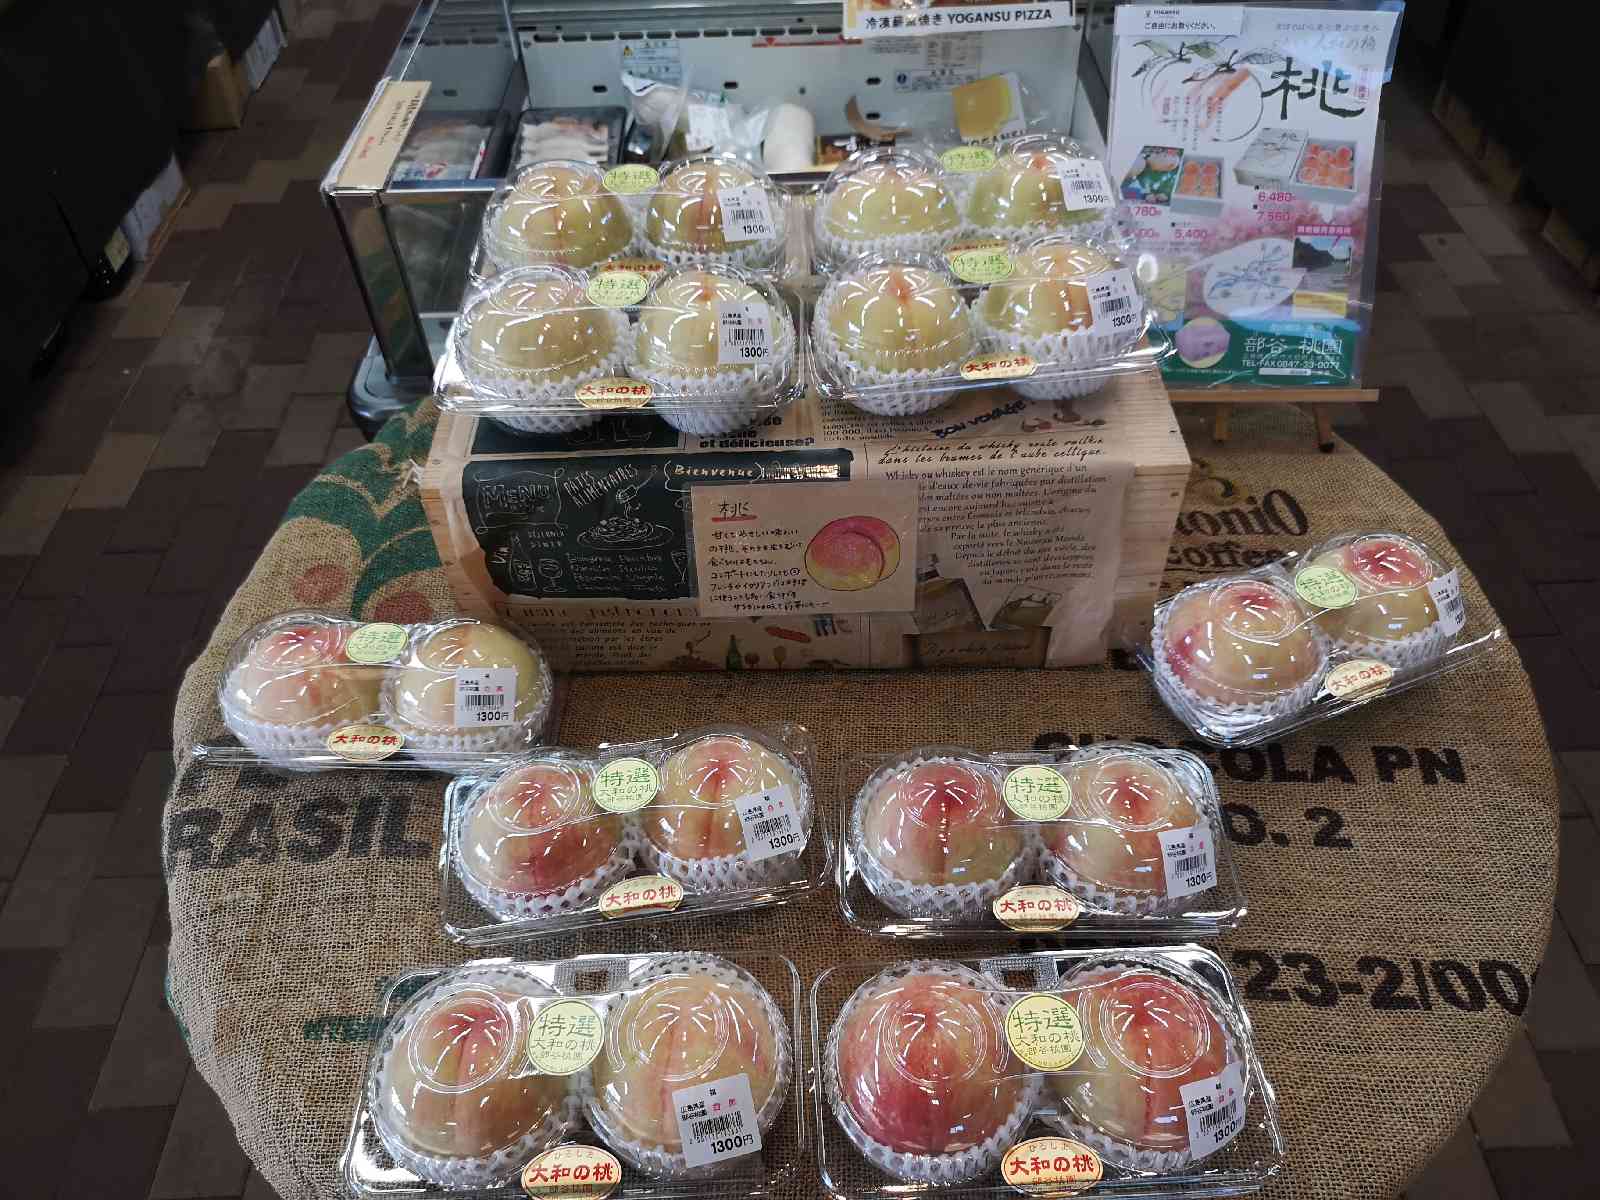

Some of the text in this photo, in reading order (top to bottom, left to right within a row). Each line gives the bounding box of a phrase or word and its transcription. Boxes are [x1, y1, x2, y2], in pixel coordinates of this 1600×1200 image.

[948, 11, 1010, 25] YOGANSU
[1014, 9, 1052, 21] PIZZA
[1260, 56, 1366, 121] 桃
[966, 357, 1031, 374] 大和の桃
[581, 384, 648, 397] 大和の桃
[674, 464, 753, 477] Bienvenue
[998, 468, 1019, 476] nom
[719, 501, 751, 519] 桃
[333, 733, 399, 746] 大和の桃
[1372, 745, 1466, 784] PN
[600, 767, 651, 787] 特選
[1007, 775, 1063, 794] 特選
[1303, 806, 1354, 848] 2
[769, 832, 801, 849] 1300円
[606, 886, 678, 908] 大和の桃
[1000, 896, 1074, 914] 大和の桃
[537, 1013, 596, 1038] 特選
[1012, 1006, 1074, 1033] 特選
[530, 1037, 596, 1052] 大和の桃
[1015, 1030, 1081, 1046] 大和の桃
[711, 1133, 754, 1155] 1300円
[529, 1161, 614, 1183] 大和の桃
[1010, 1153, 1095, 1176] 大和の桃
